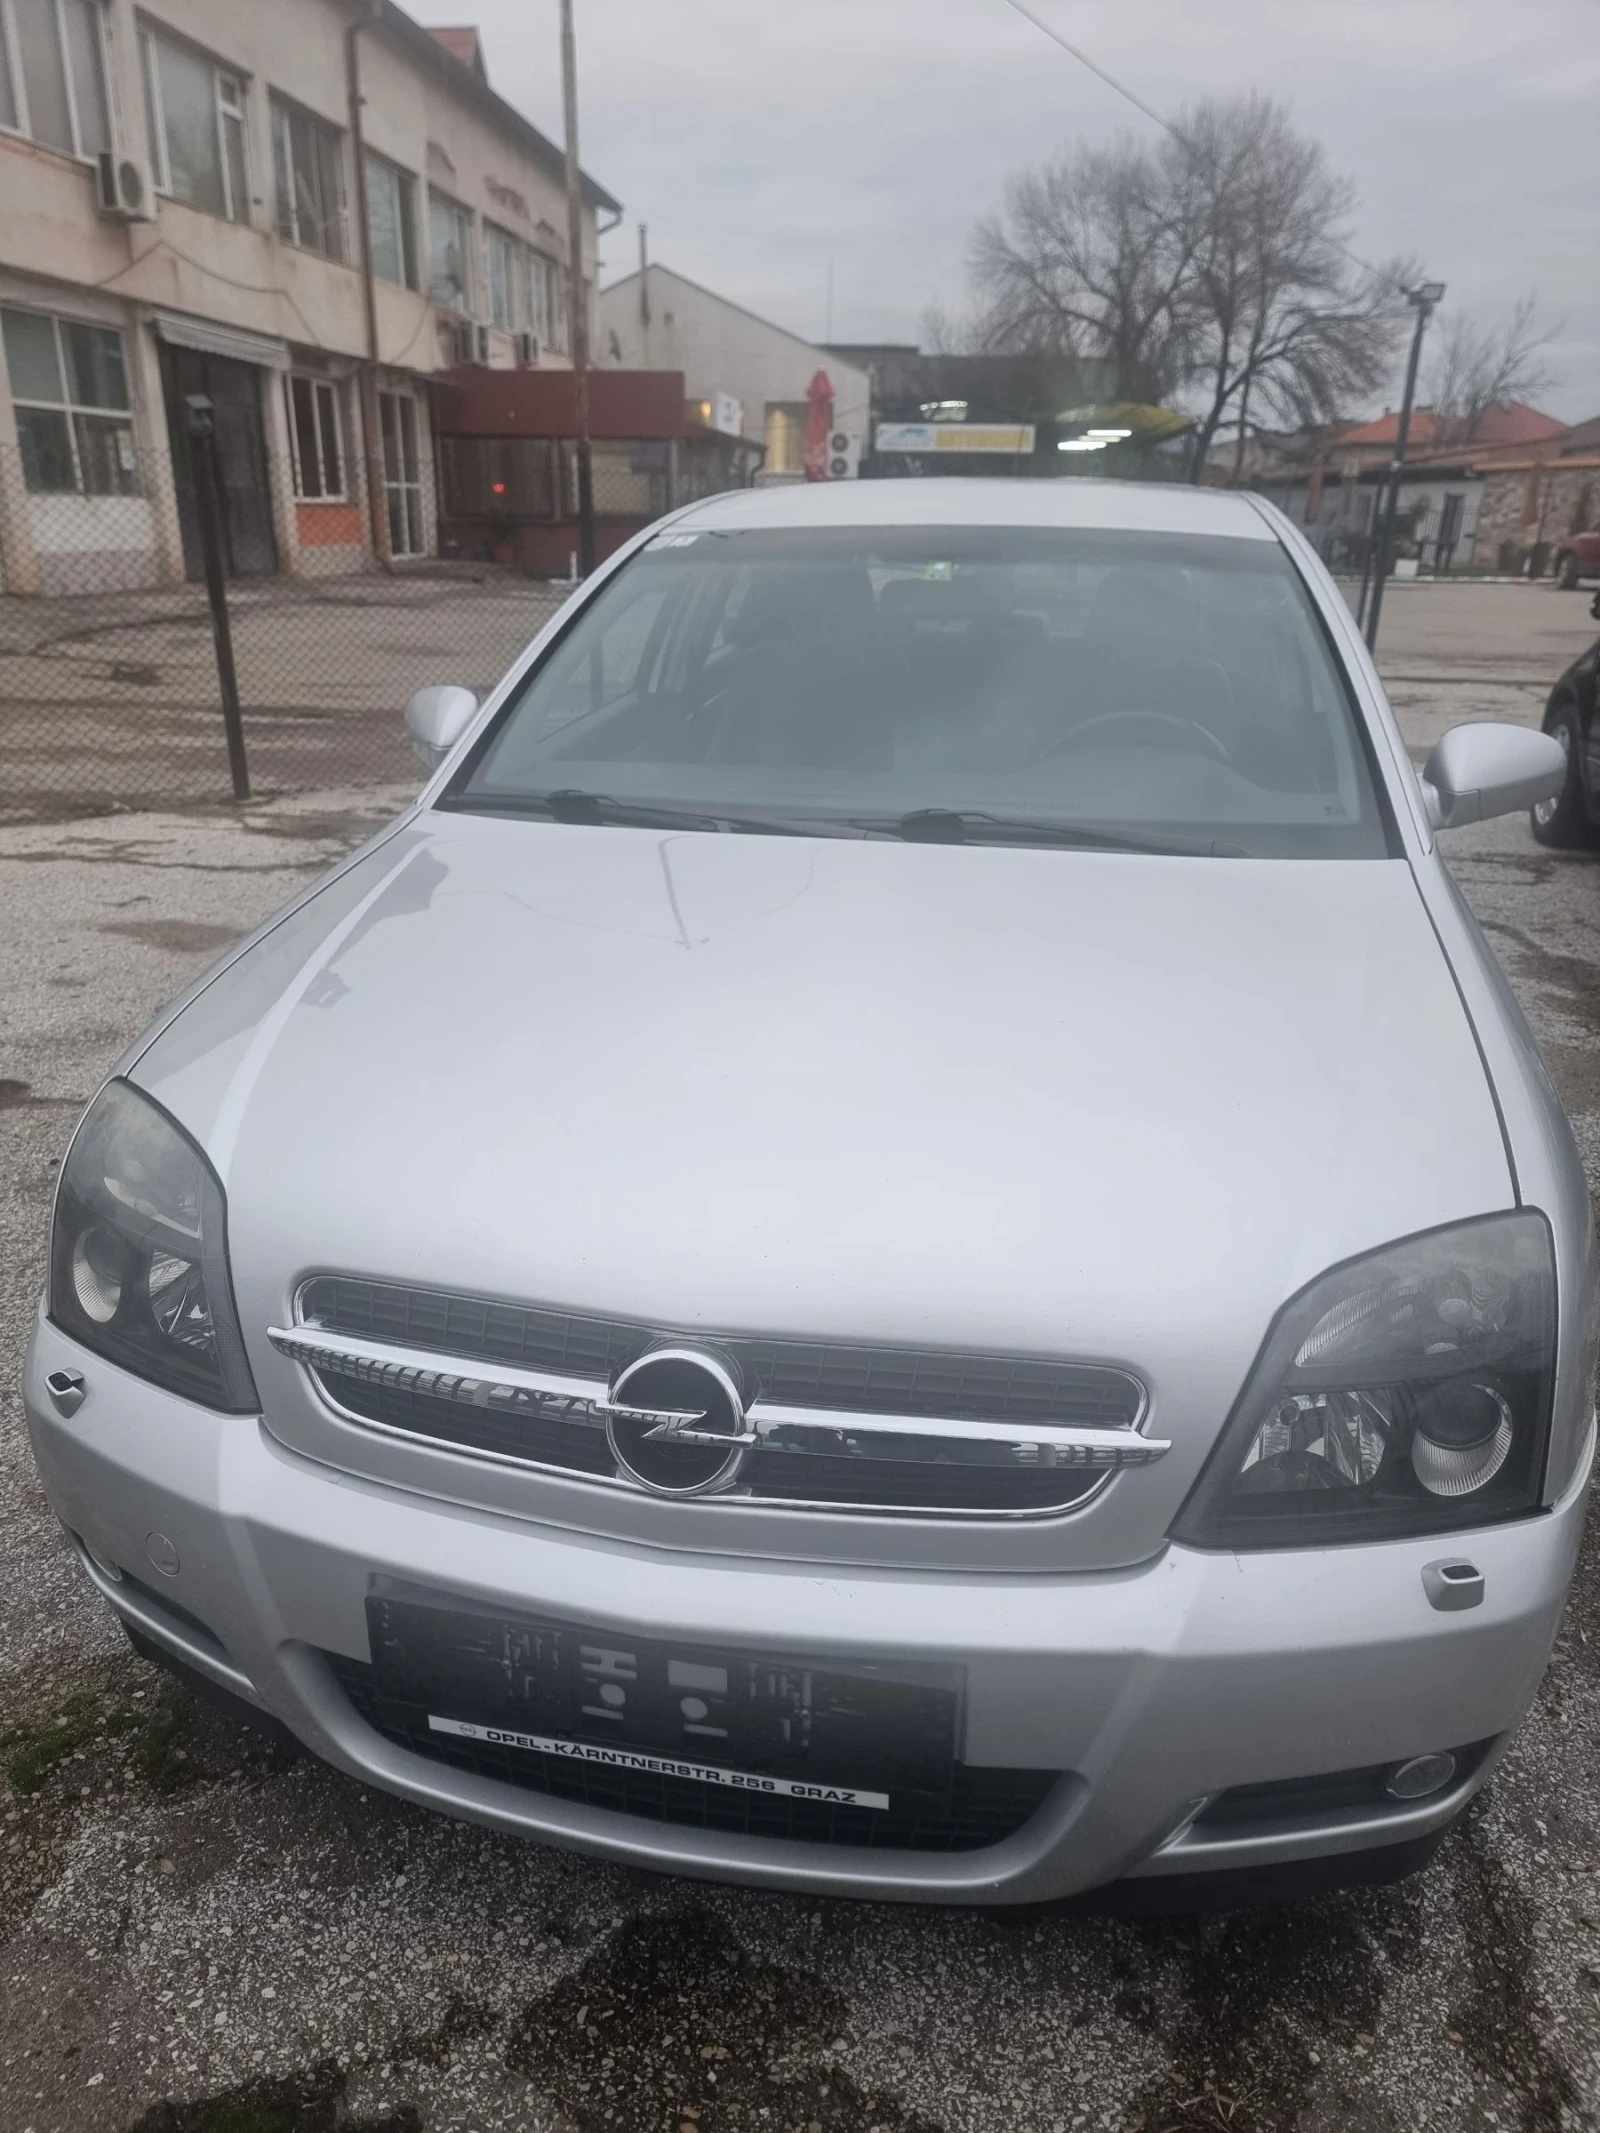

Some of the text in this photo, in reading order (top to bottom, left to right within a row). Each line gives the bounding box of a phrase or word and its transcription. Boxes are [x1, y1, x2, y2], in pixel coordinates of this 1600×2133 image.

[487, 1731, 540, 1749] OPEL
[731, 1775, 775, 1791] 256
[791, 1785, 856, 1803] GRAZ
